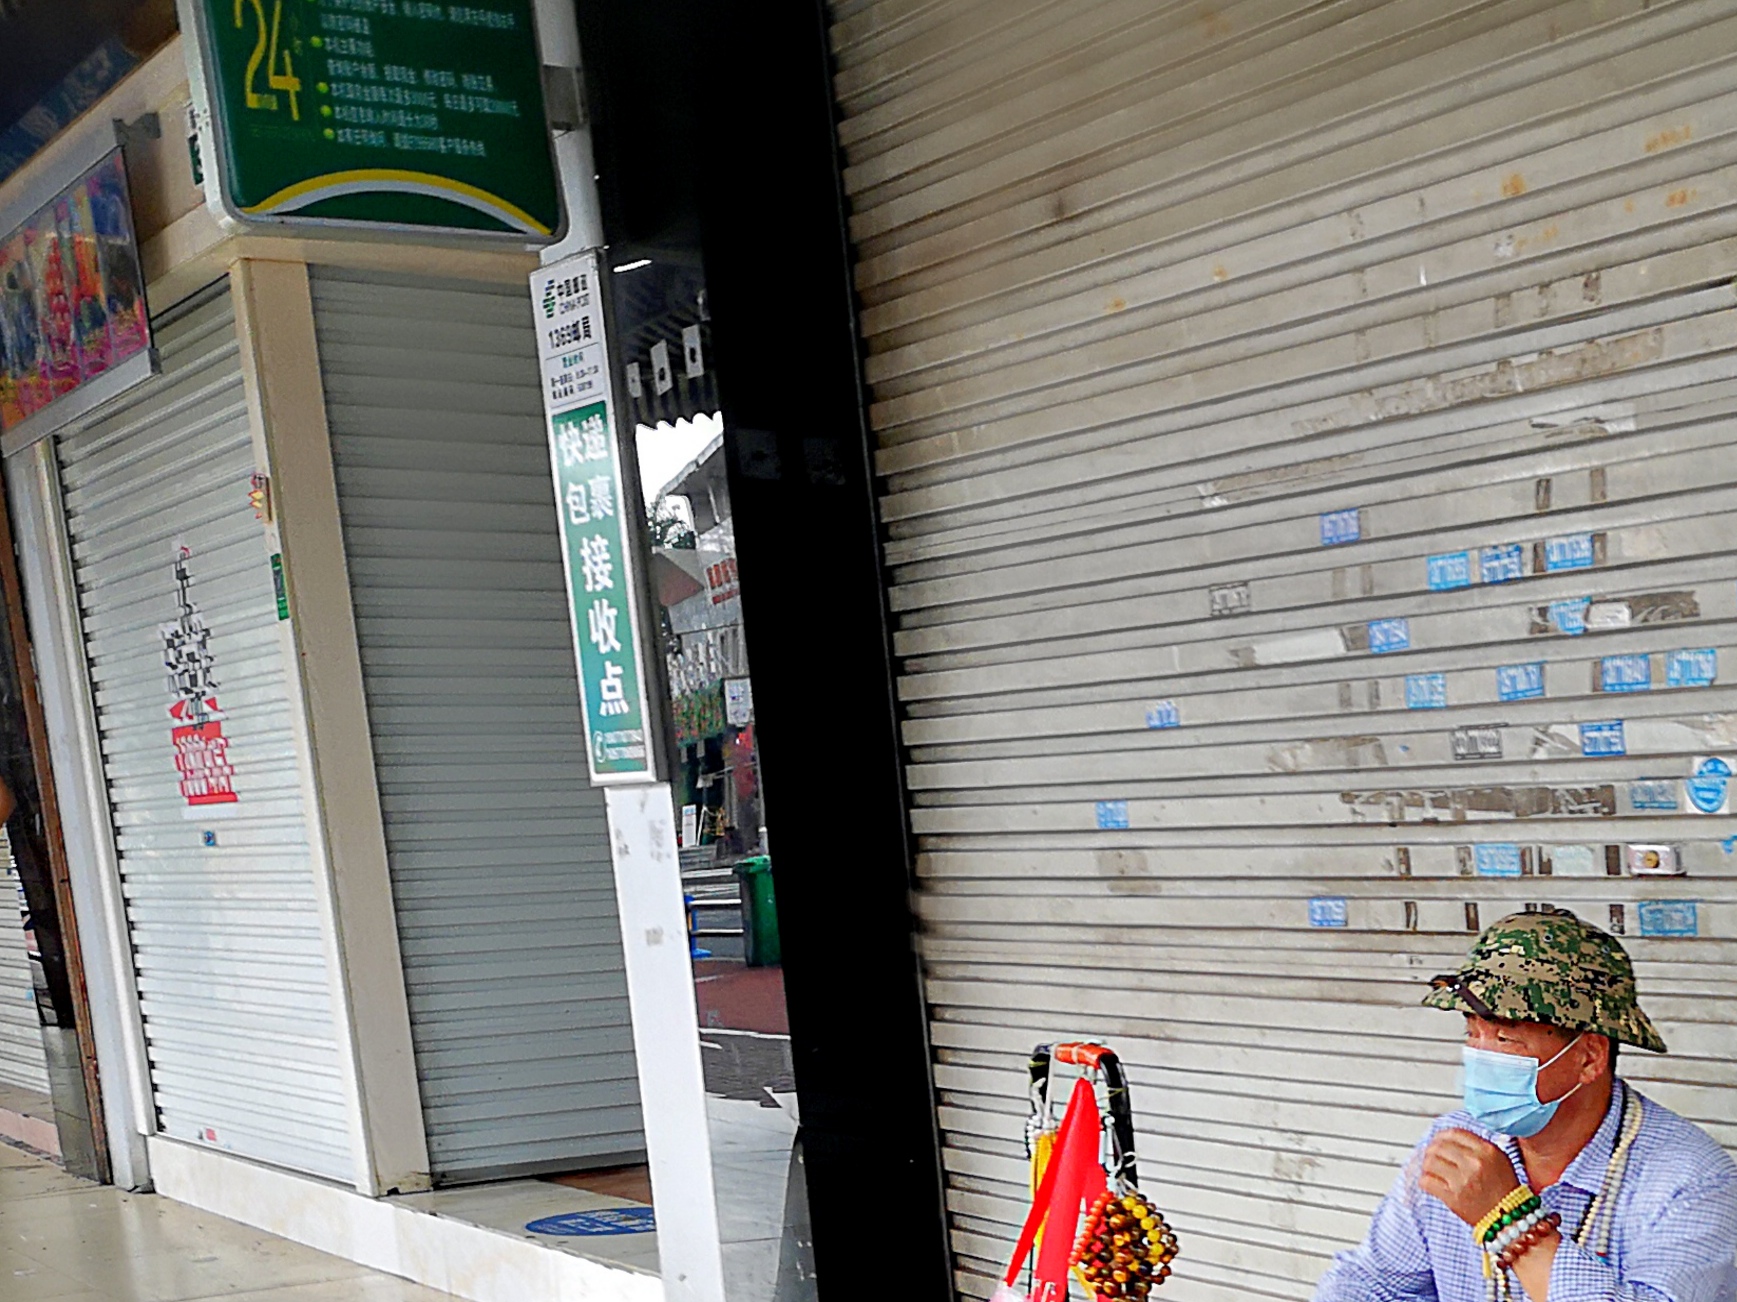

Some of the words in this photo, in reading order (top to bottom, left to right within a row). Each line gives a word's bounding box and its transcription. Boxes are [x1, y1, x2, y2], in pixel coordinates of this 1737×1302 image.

[566, 475, 614, 525] 包裹
[580, 533, 630, 716] 接收点
